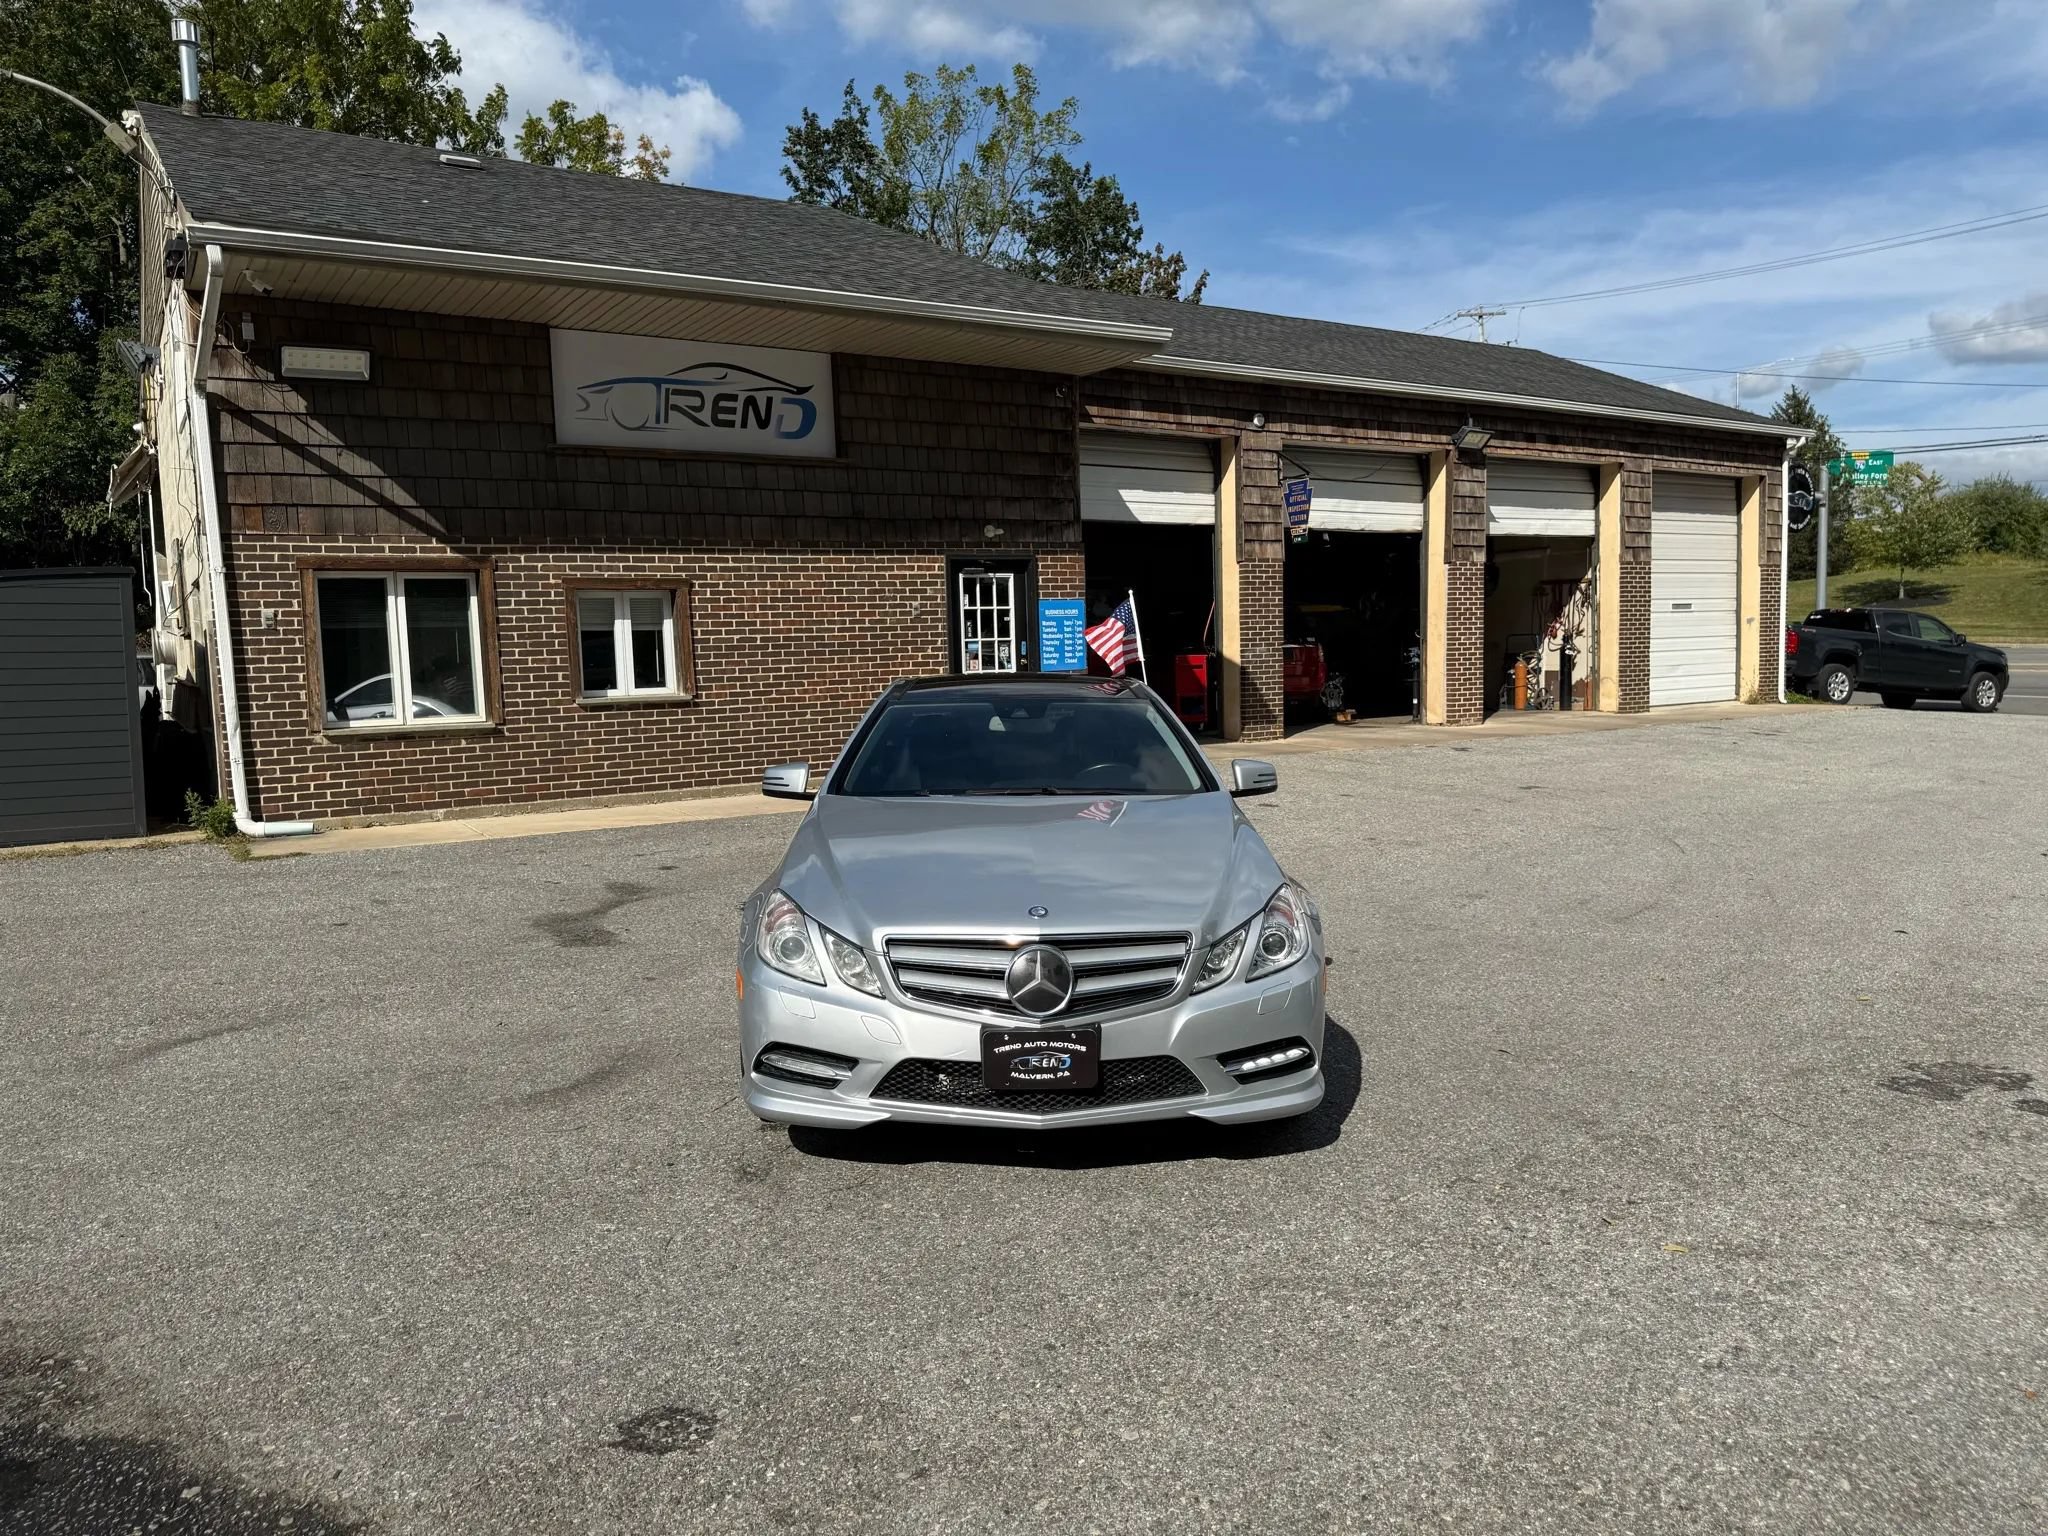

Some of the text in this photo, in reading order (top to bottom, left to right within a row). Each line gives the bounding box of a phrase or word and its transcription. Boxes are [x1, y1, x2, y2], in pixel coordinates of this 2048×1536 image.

[643, 376, 818, 440] TREND
[1870, 472, 1888, 480] Forg
[1289, 495, 1307, 503] OFFICIAL
[1290, 514, 1307, 522] STATION
[993, 1042, 1022, 1054] TREND
[1049, 1041, 1087, 1052] MOTORS
[1056, 1070, 1071, 1078] PA
